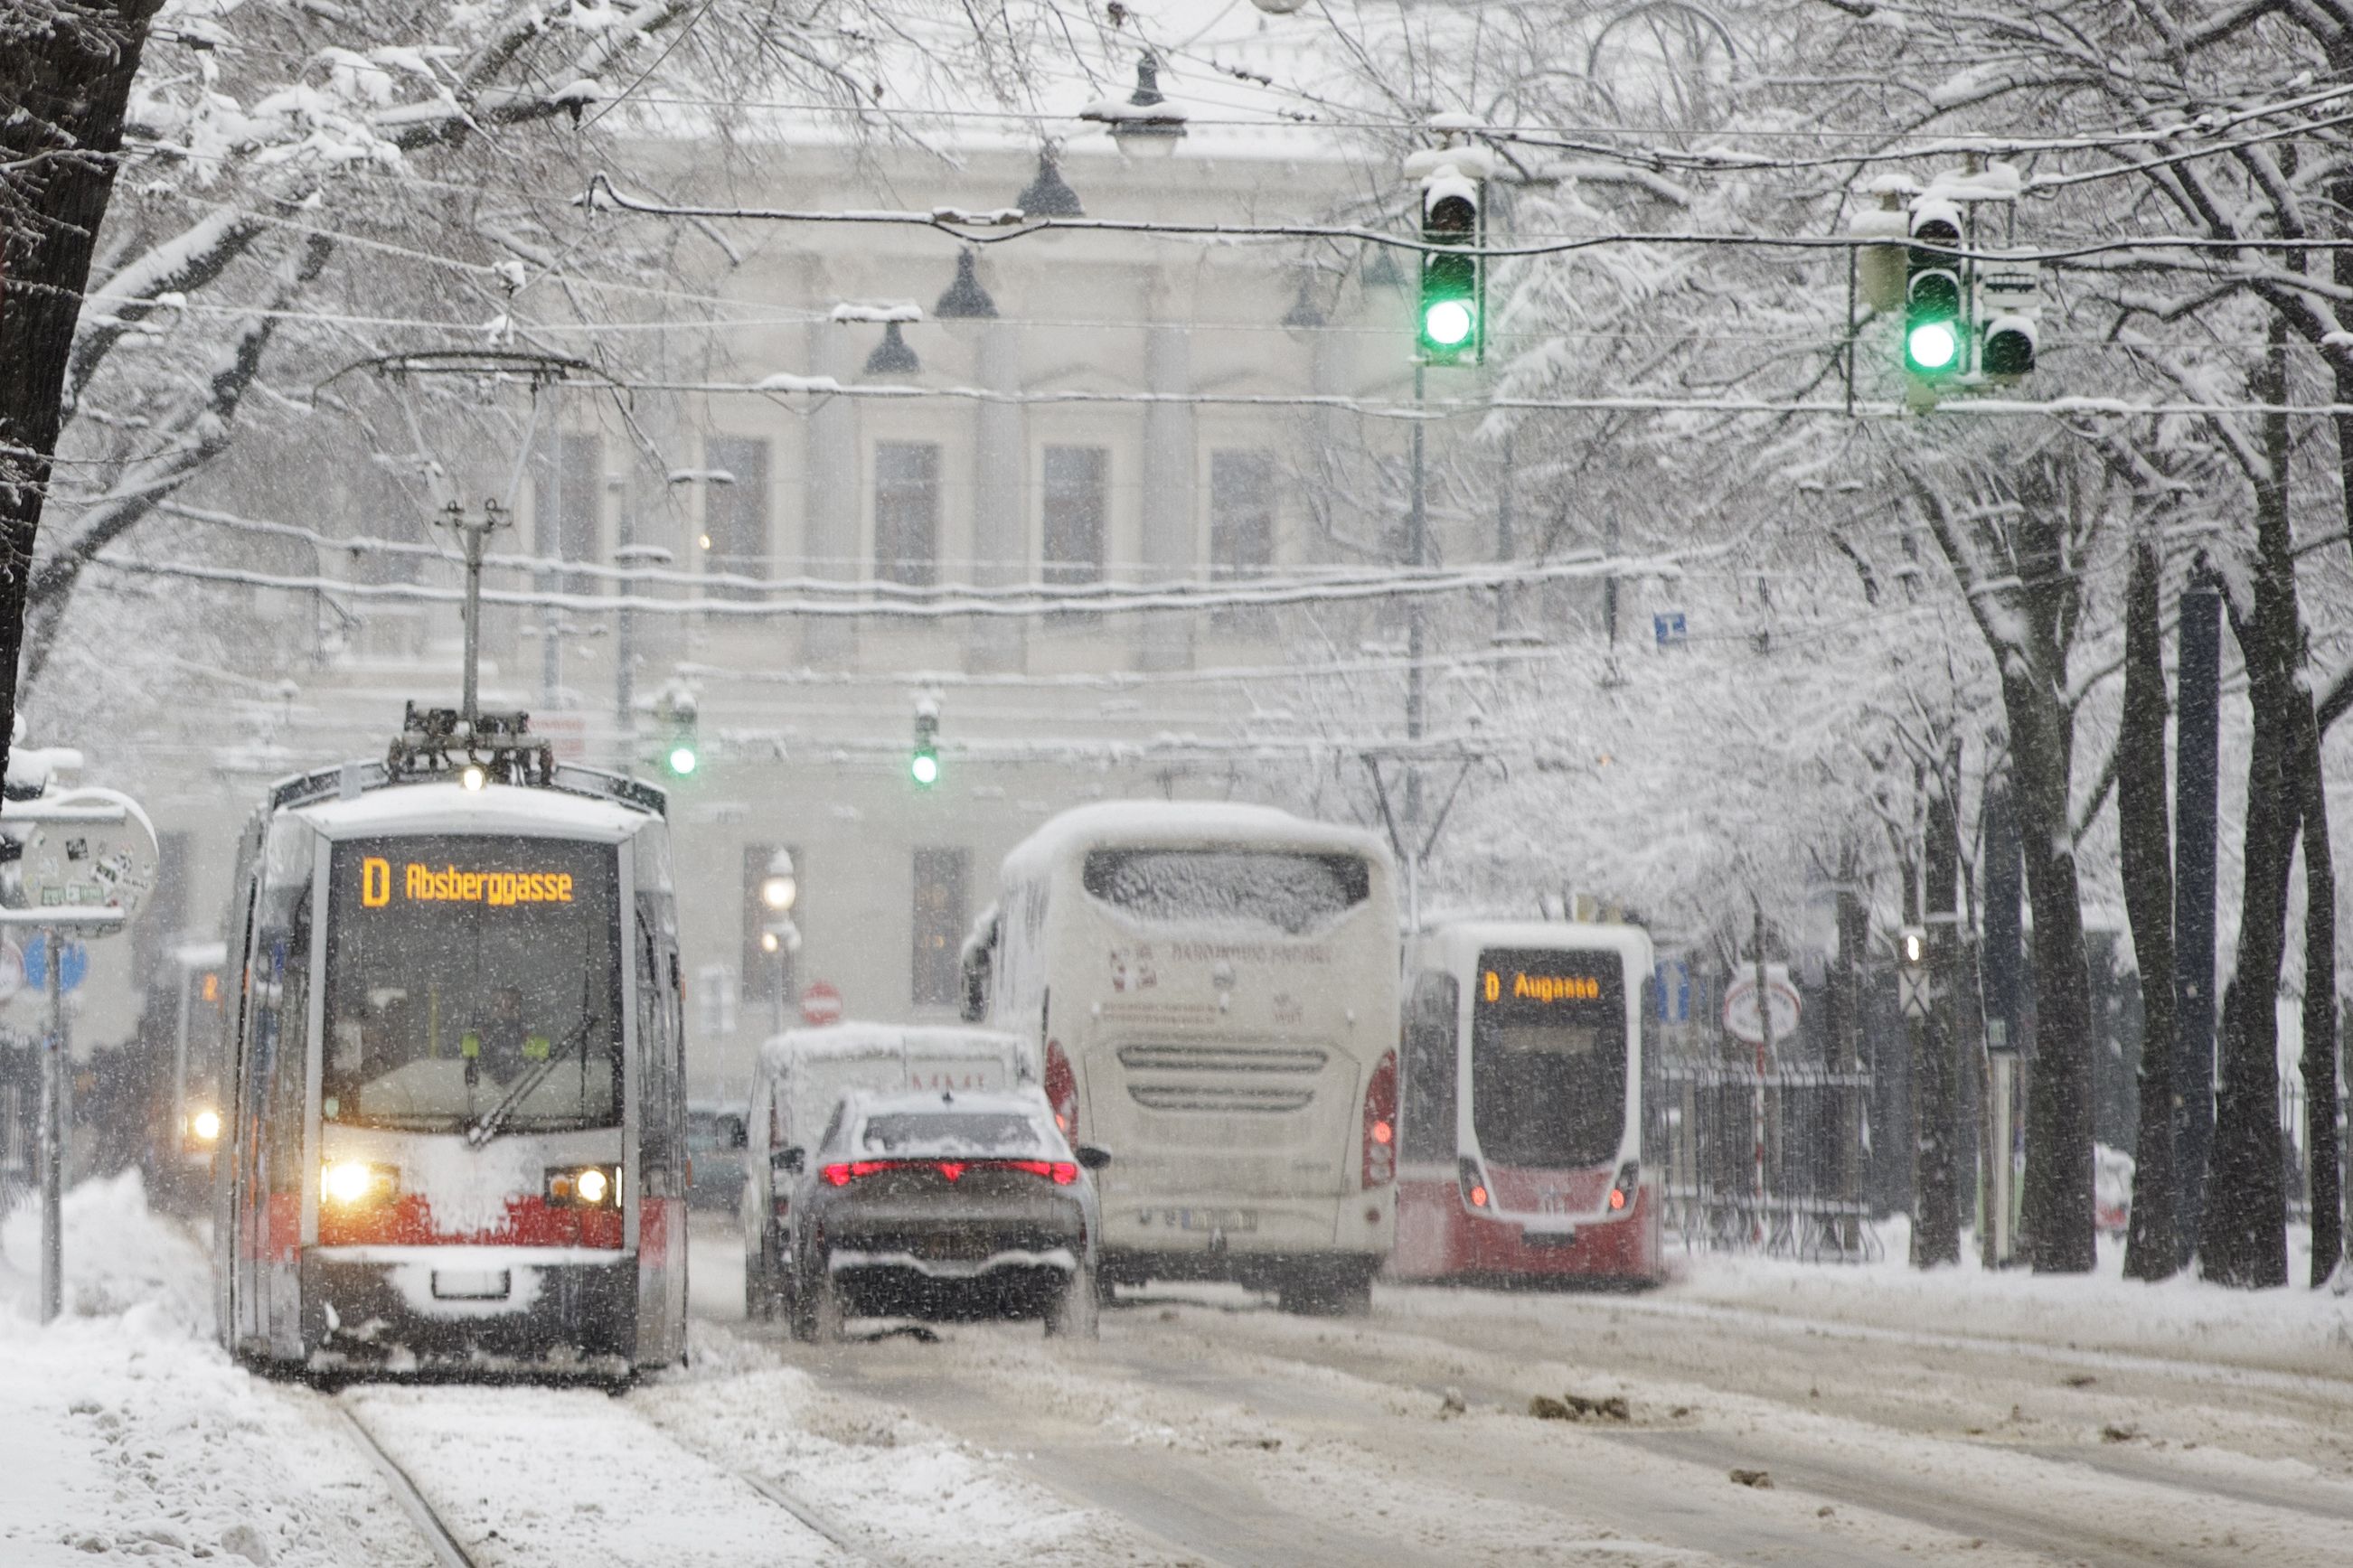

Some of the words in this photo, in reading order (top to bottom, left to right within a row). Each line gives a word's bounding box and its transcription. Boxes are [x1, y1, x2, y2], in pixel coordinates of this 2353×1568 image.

[362, 858, 391, 907] D
[406, 863, 572, 906] Absberggasse
[1484, 971, 1501, 1002] D
